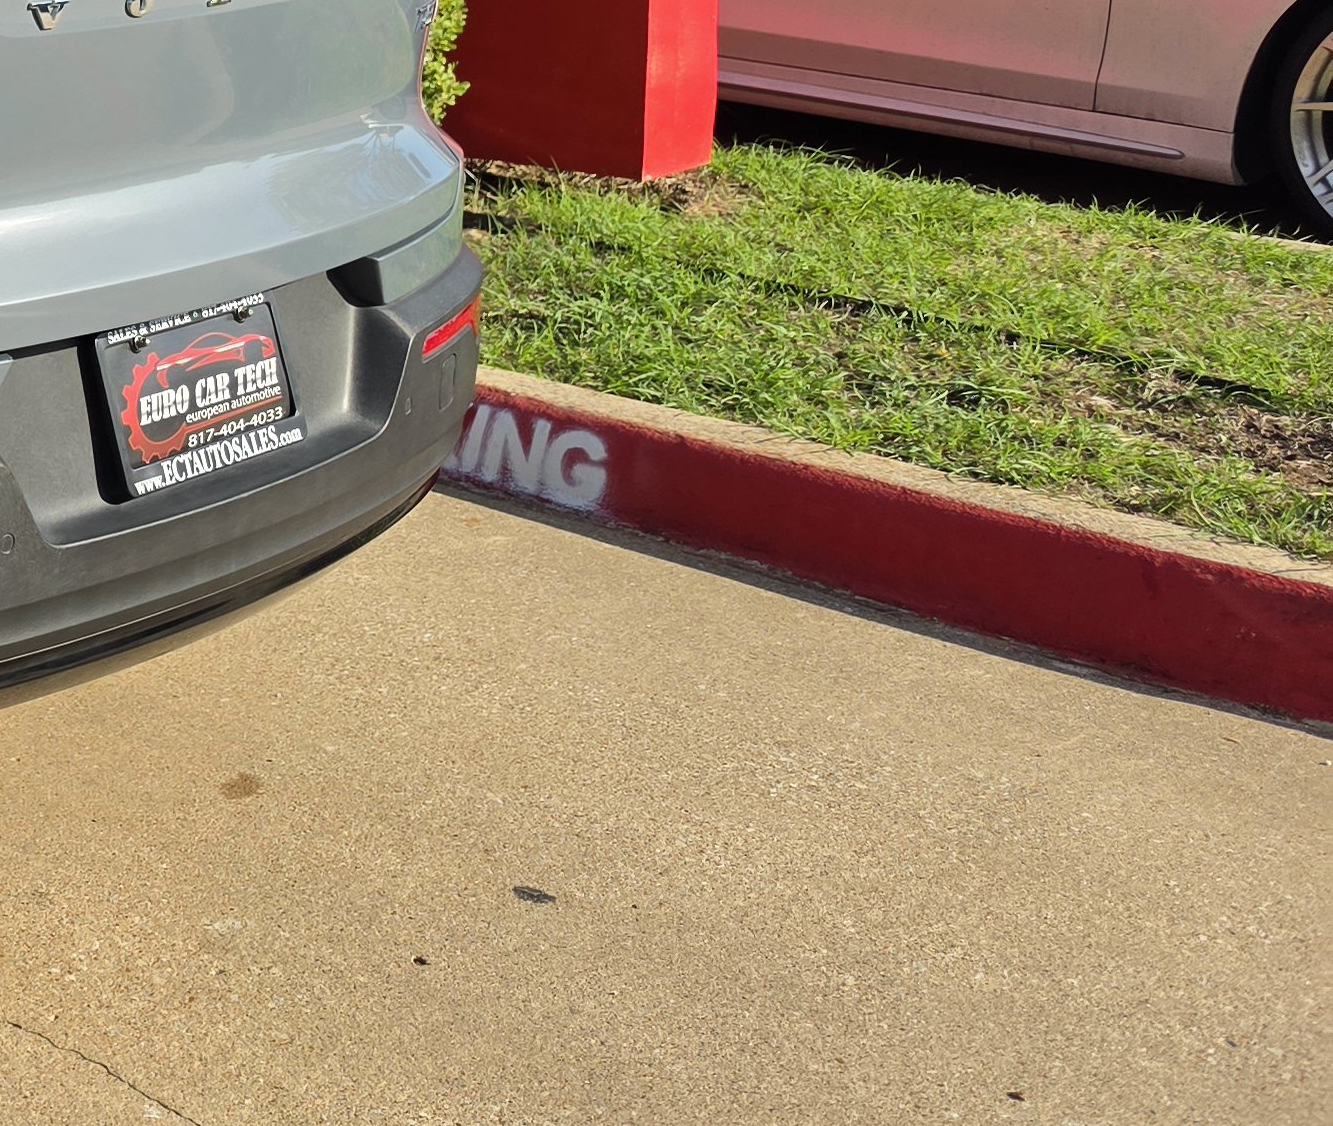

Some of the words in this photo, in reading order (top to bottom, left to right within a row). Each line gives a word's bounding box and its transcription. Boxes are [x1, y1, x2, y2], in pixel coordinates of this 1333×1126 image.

[139, 384, 190, 427] EURO
[195, 372, 231, 408] CAR
[234, 356, 279, 396] TECH
[185, 400, 230, 424] european
[230, 385, 282, 410] automotive
[187, 405, 284, 448] 817-404-4033
[445, 403, 610, 511] ING
